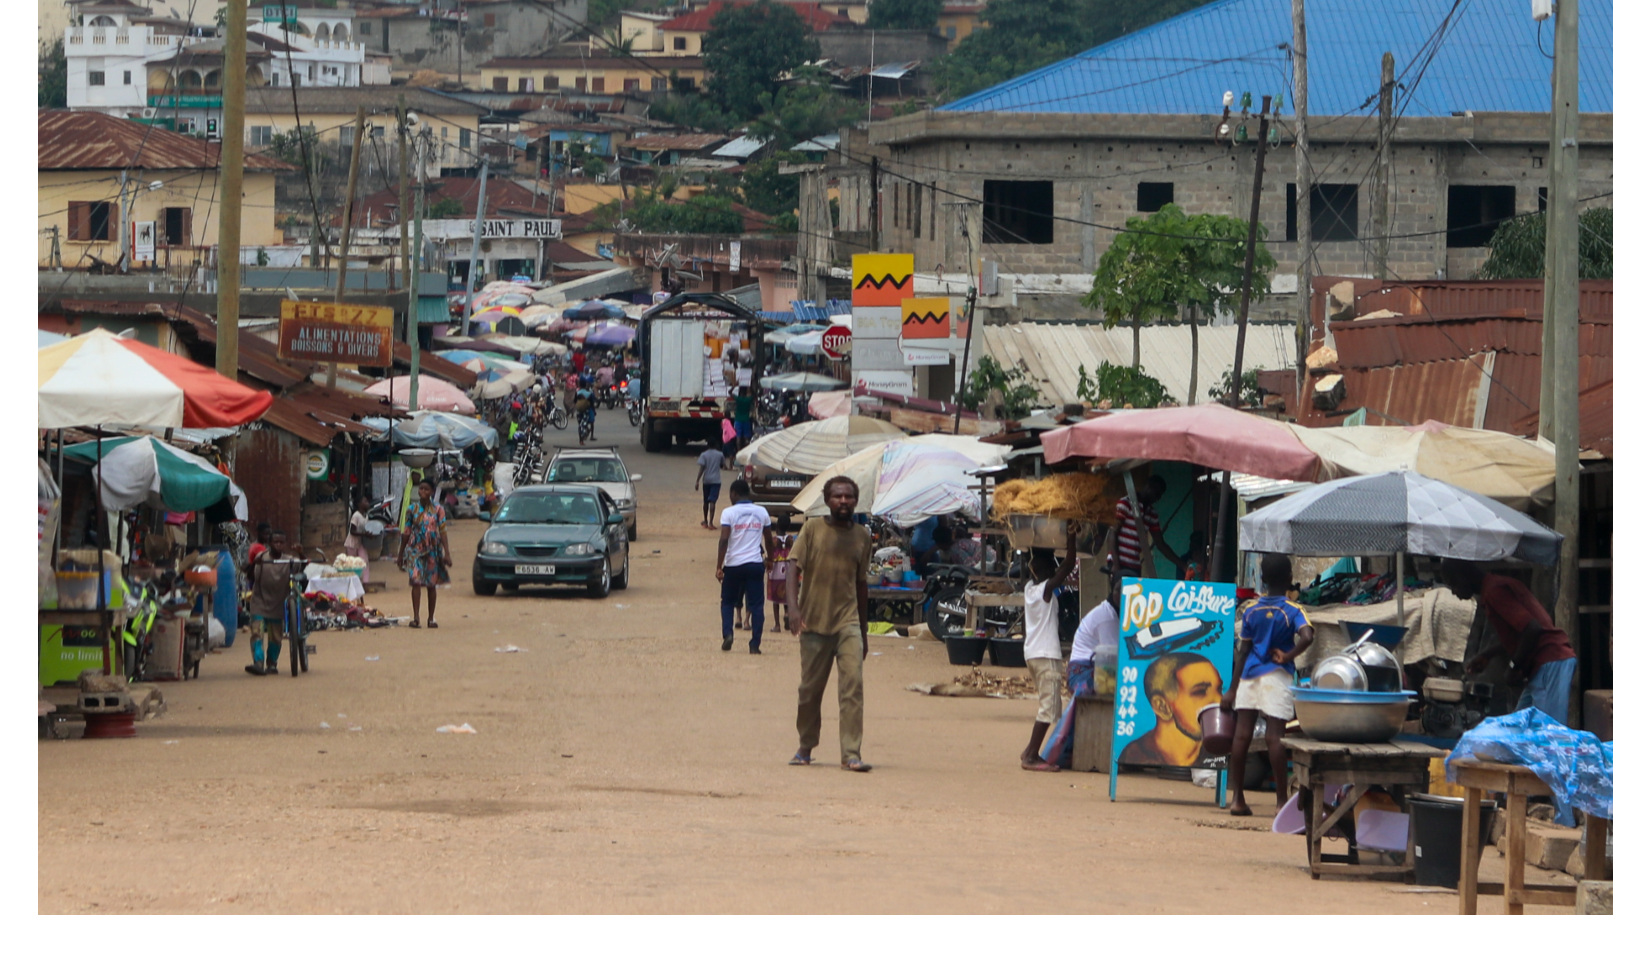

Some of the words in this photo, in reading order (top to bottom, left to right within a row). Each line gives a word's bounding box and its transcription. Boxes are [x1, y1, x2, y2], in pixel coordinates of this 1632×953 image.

[481, 221, 514, 236] SAINT
[524, 221, 556, 236] PAUL
[880, 318, 902, 330] Tog
[299, 327, 381, 345] ALIMENTATIONS
[824, 335, 852, 349] STOP
[291, 339, 333, 354] BOISSONS
[348, 343, 379, 357] DIVERS
[868, 379, 908, 389] MoneyGram
[1122, 583, 1164, 631] Top
[60, 651, 75, 661] no
[78, 649, 103, 661] limit
[1122, 666, 1138, 684] 90
[1118, 703, 1138, 719] 44
[1116, 720, 1135, 736] 36
